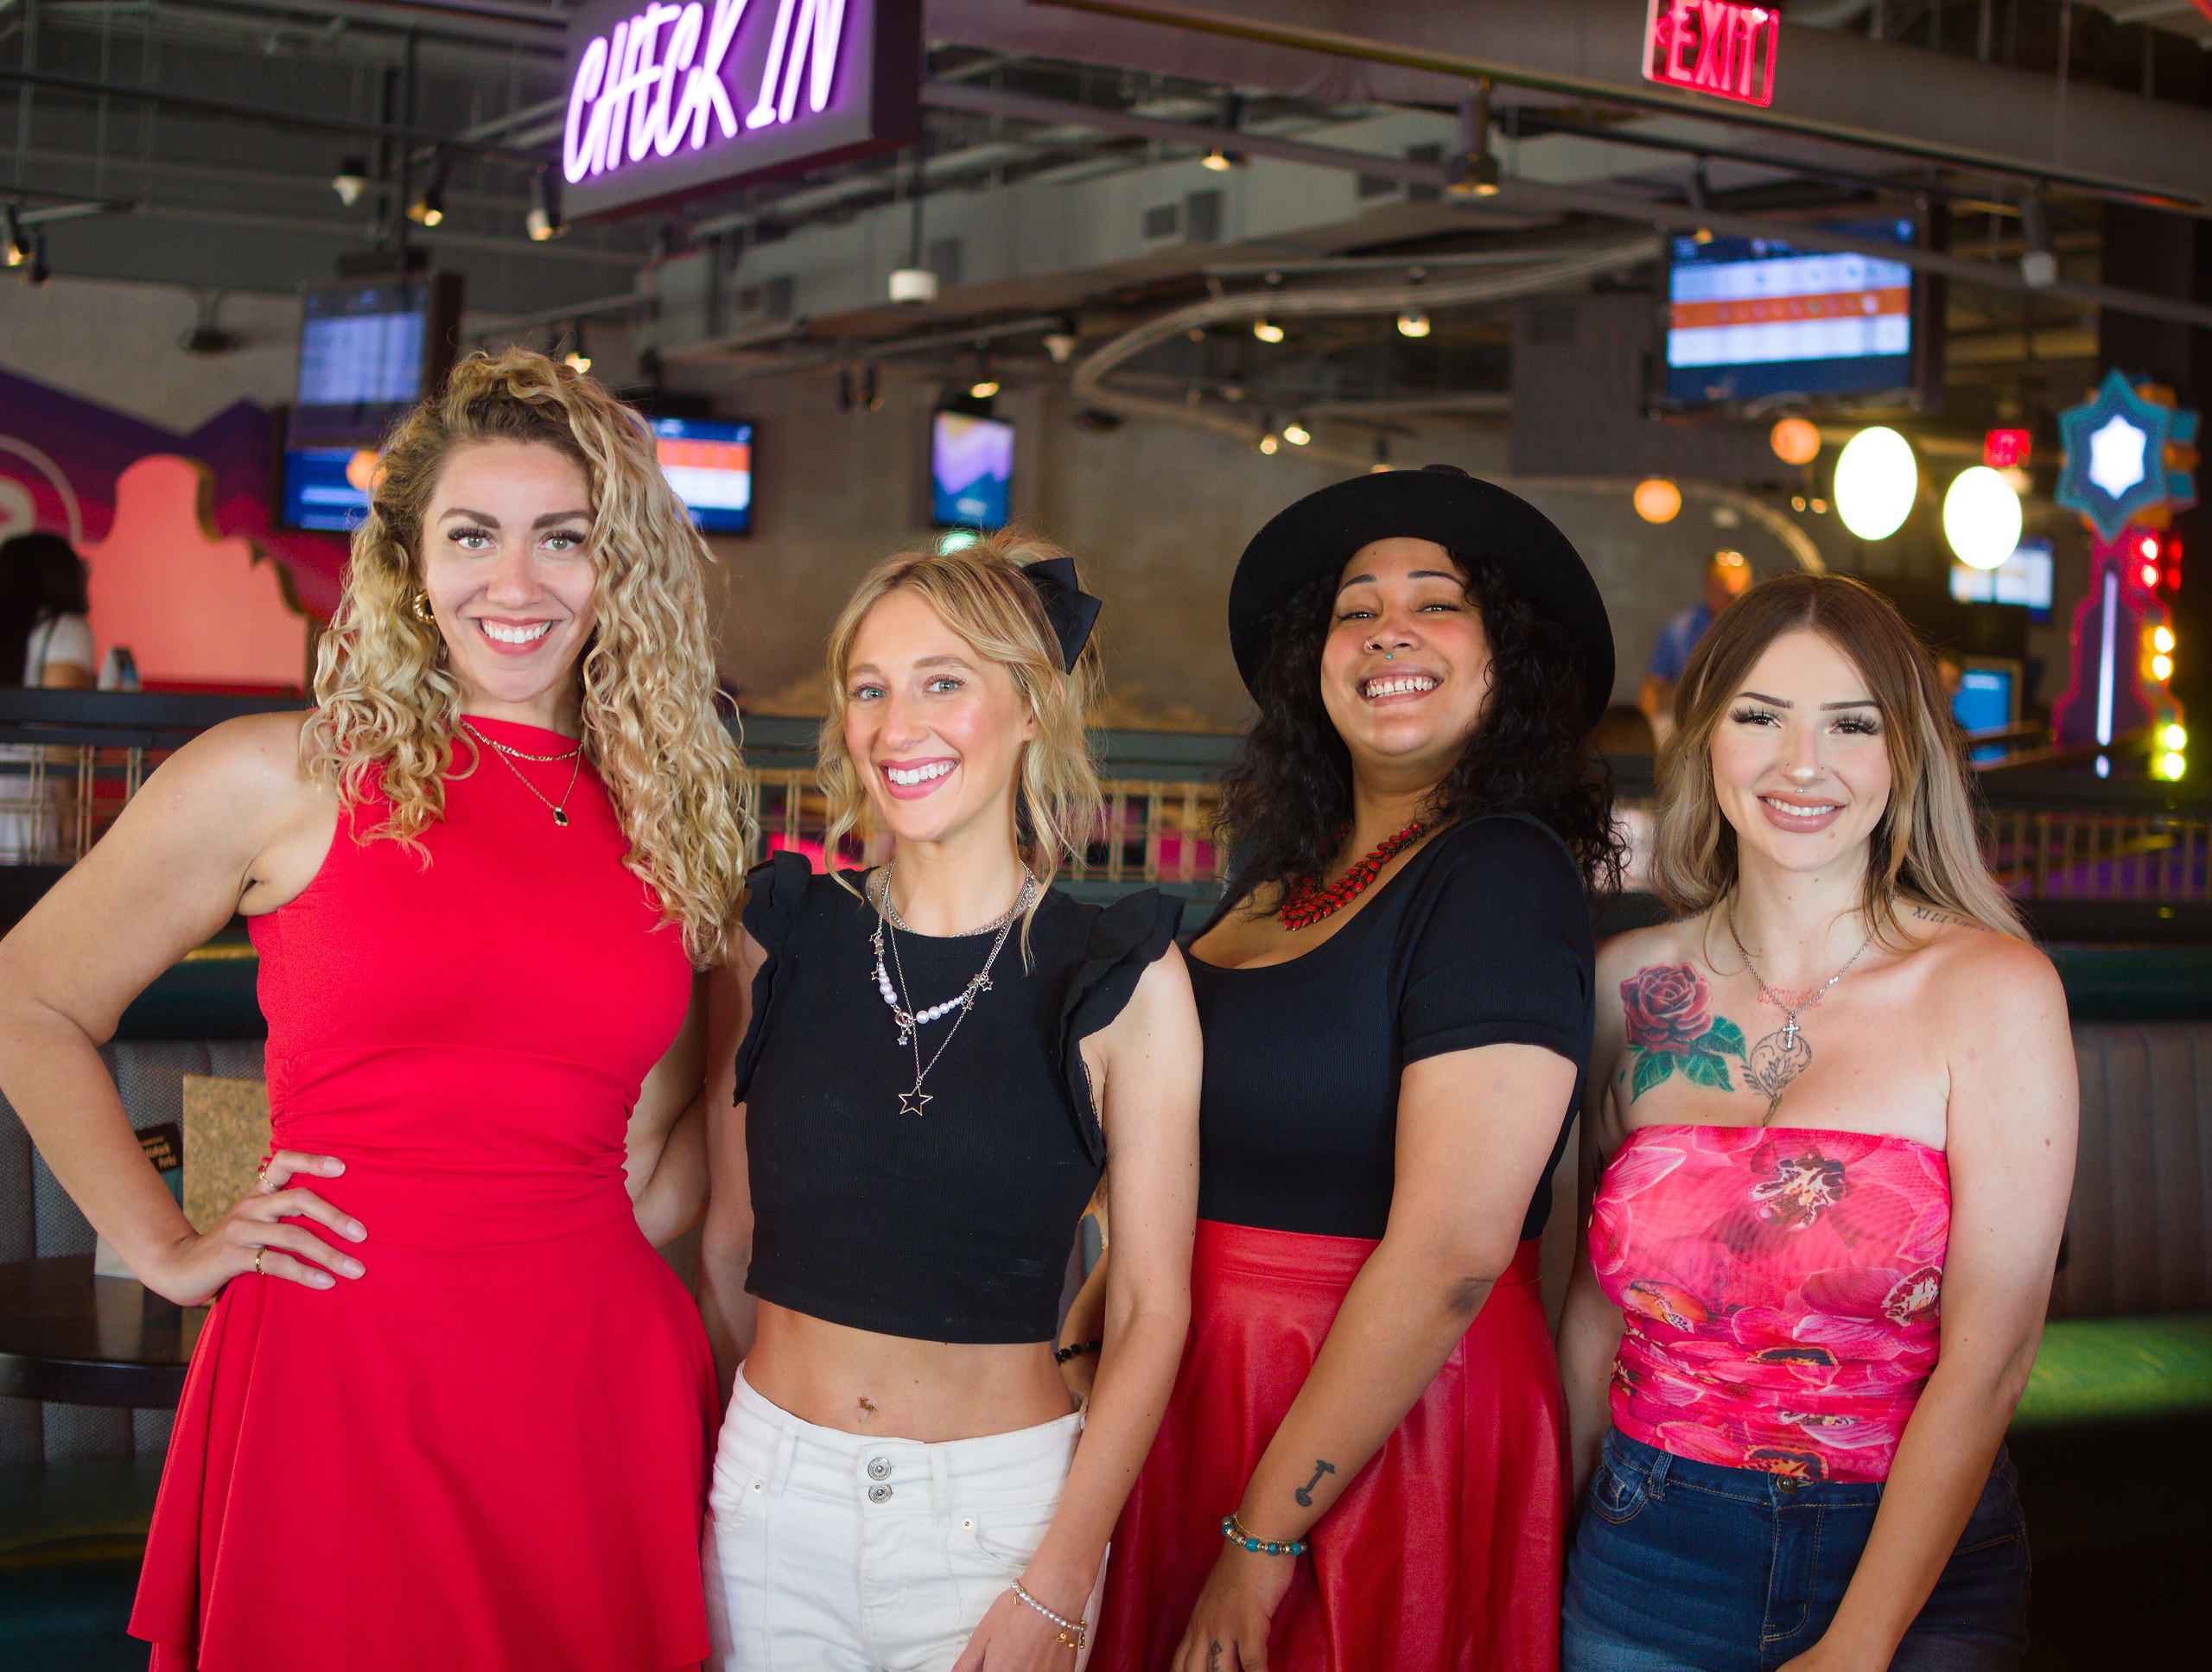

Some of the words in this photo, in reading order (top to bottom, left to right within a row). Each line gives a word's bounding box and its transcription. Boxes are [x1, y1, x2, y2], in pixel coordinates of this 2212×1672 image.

[563, 0, 747, 184] CHECK
[746, 0, 846, 130] IN
[1665, 0, 1769, 97] EXIT
